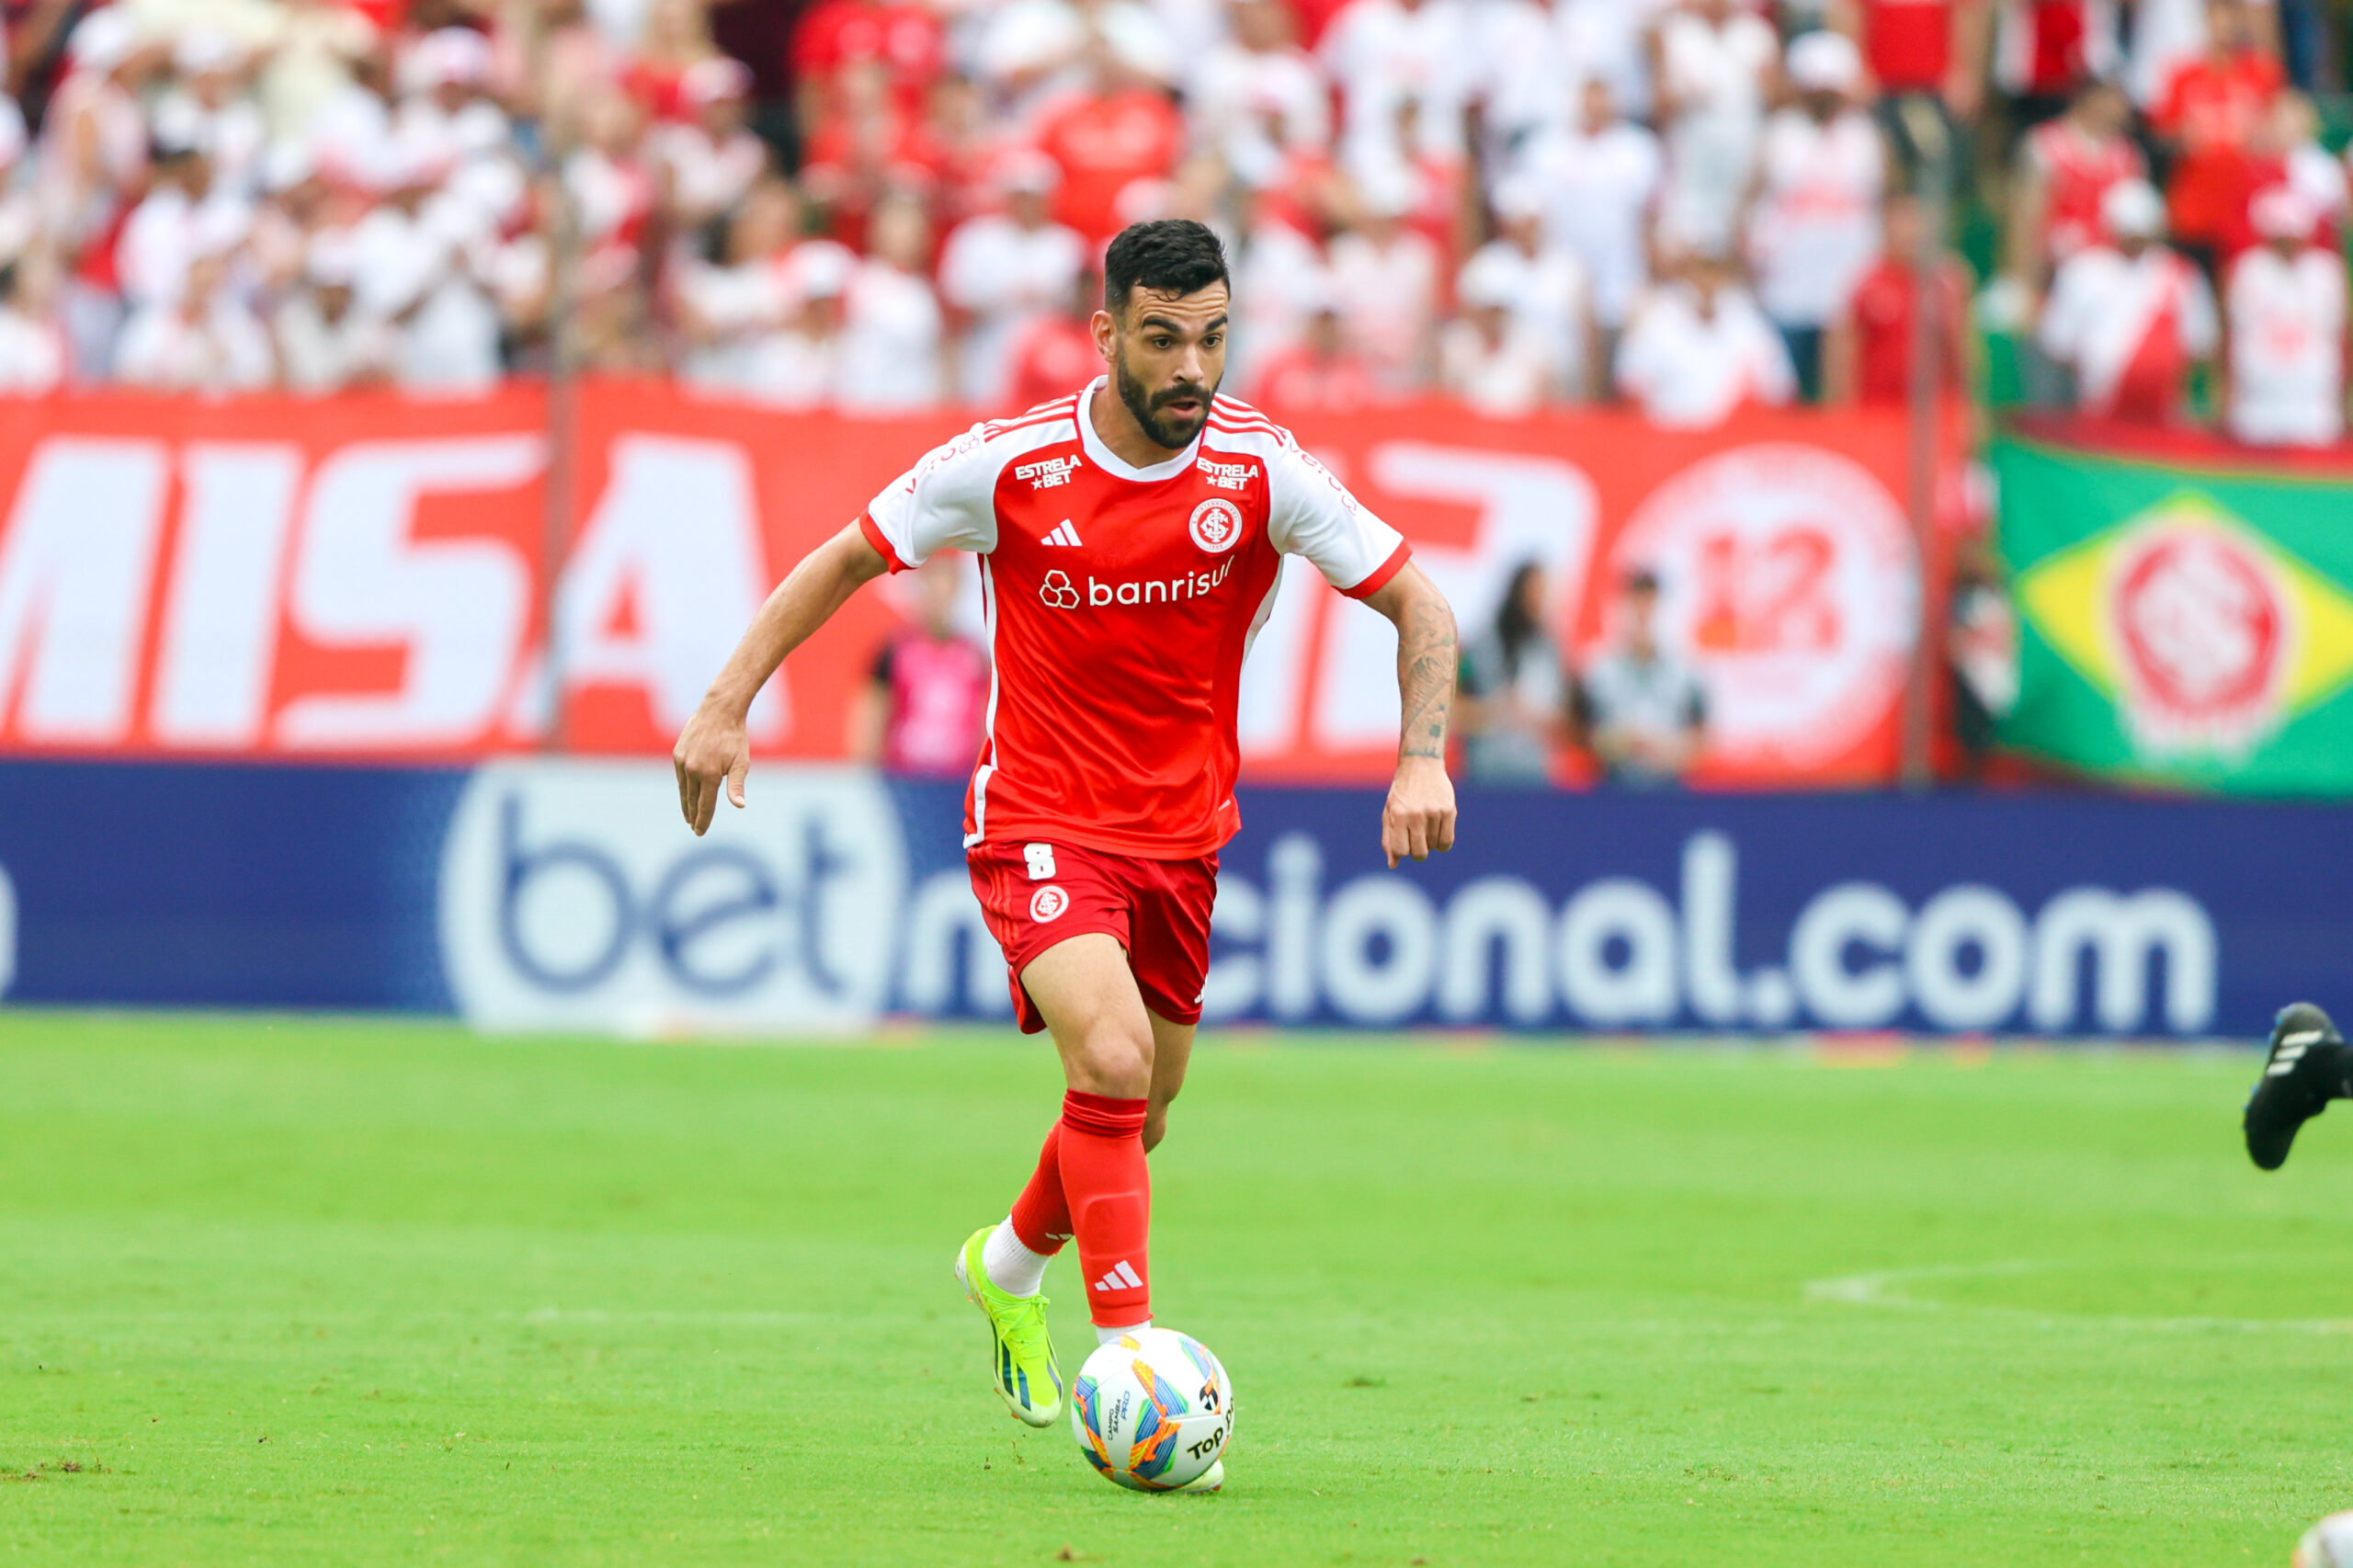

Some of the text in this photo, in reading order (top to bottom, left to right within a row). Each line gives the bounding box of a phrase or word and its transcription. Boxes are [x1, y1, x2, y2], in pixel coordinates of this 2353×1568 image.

[1014, 454, 1083, 481] ESTRELA
[1042, 470, 1072, 489] BET
[1196, 456, 1258, 478] ESTRELA
[1217, 475, 1248, 491] BET
[1088, 554, 1235, 607] banrisul
[1023, 842, 1056, 881] 8
[904, 829, 2218, 1032] ncional.com
[1121, 1390, 1131, 1420] PRO
